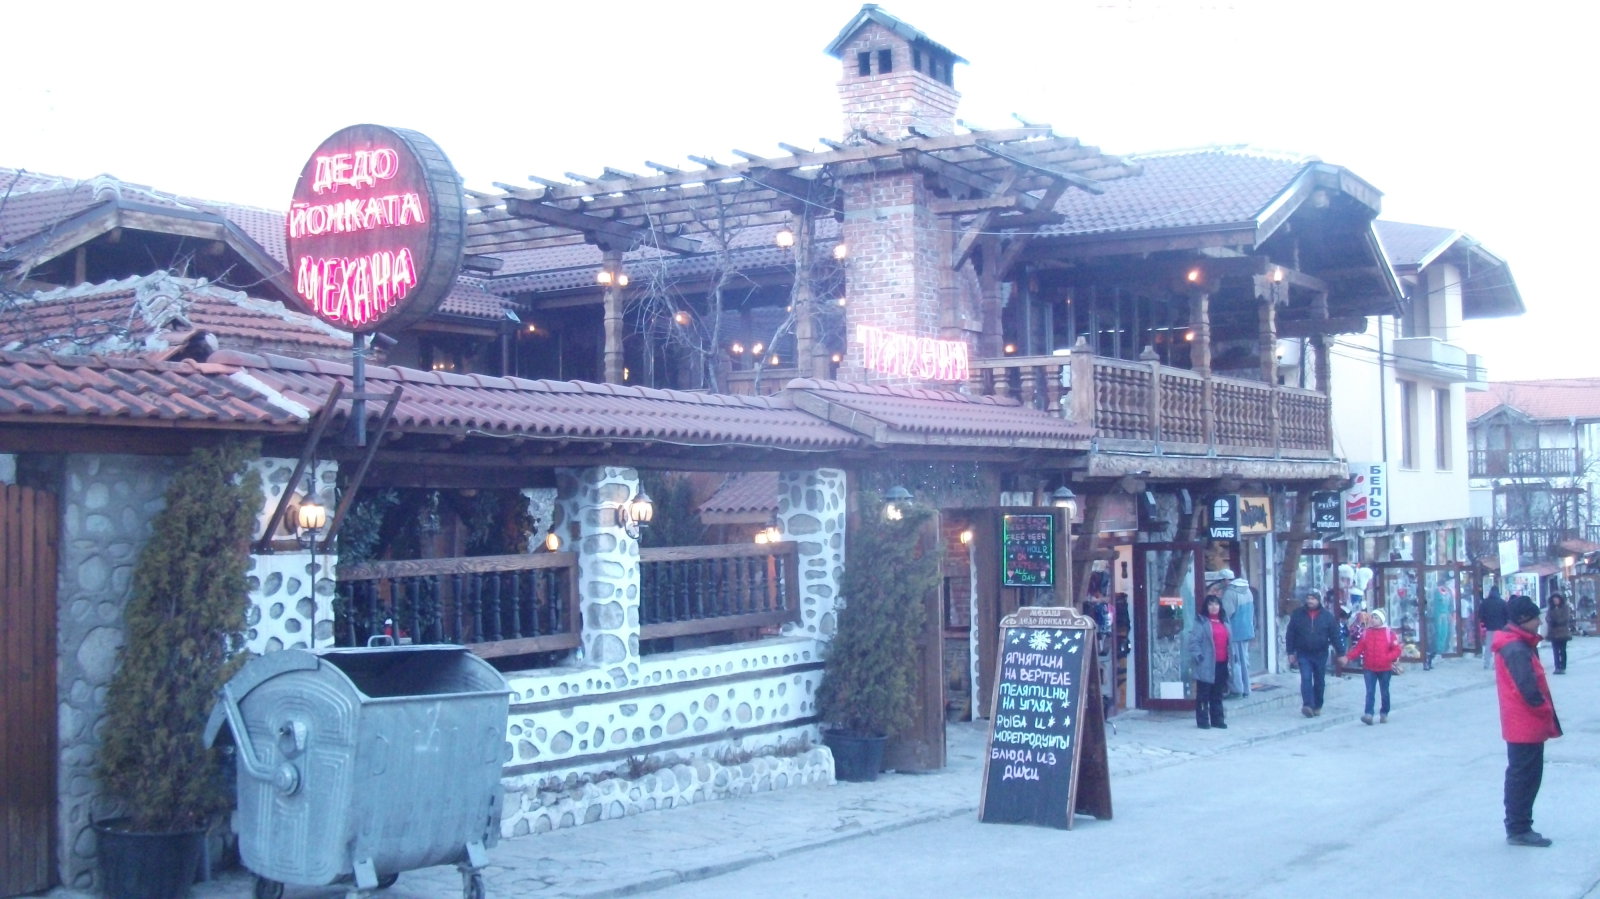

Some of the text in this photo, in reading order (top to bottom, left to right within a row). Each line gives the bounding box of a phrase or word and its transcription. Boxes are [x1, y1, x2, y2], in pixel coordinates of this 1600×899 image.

[313, 148, 398, 194] ДЕДО
[289, 193, 425, 238] ЙОНКАТА
[297, 248, 417, 328] МЕХАНА
[1369, 465, 1382, 518] БЕЛЬО
[1210, 527, 1235, 538] VANS
[1005, 667, 1072, 686] НА ВЕРТЕЛЕ
[1003, 696, 1053, 713] НА УГЛЯХ
[997, 715, 1027, 728] РЫБА
[992, 747, 1057, 765] БЛЮДА ИЗ
